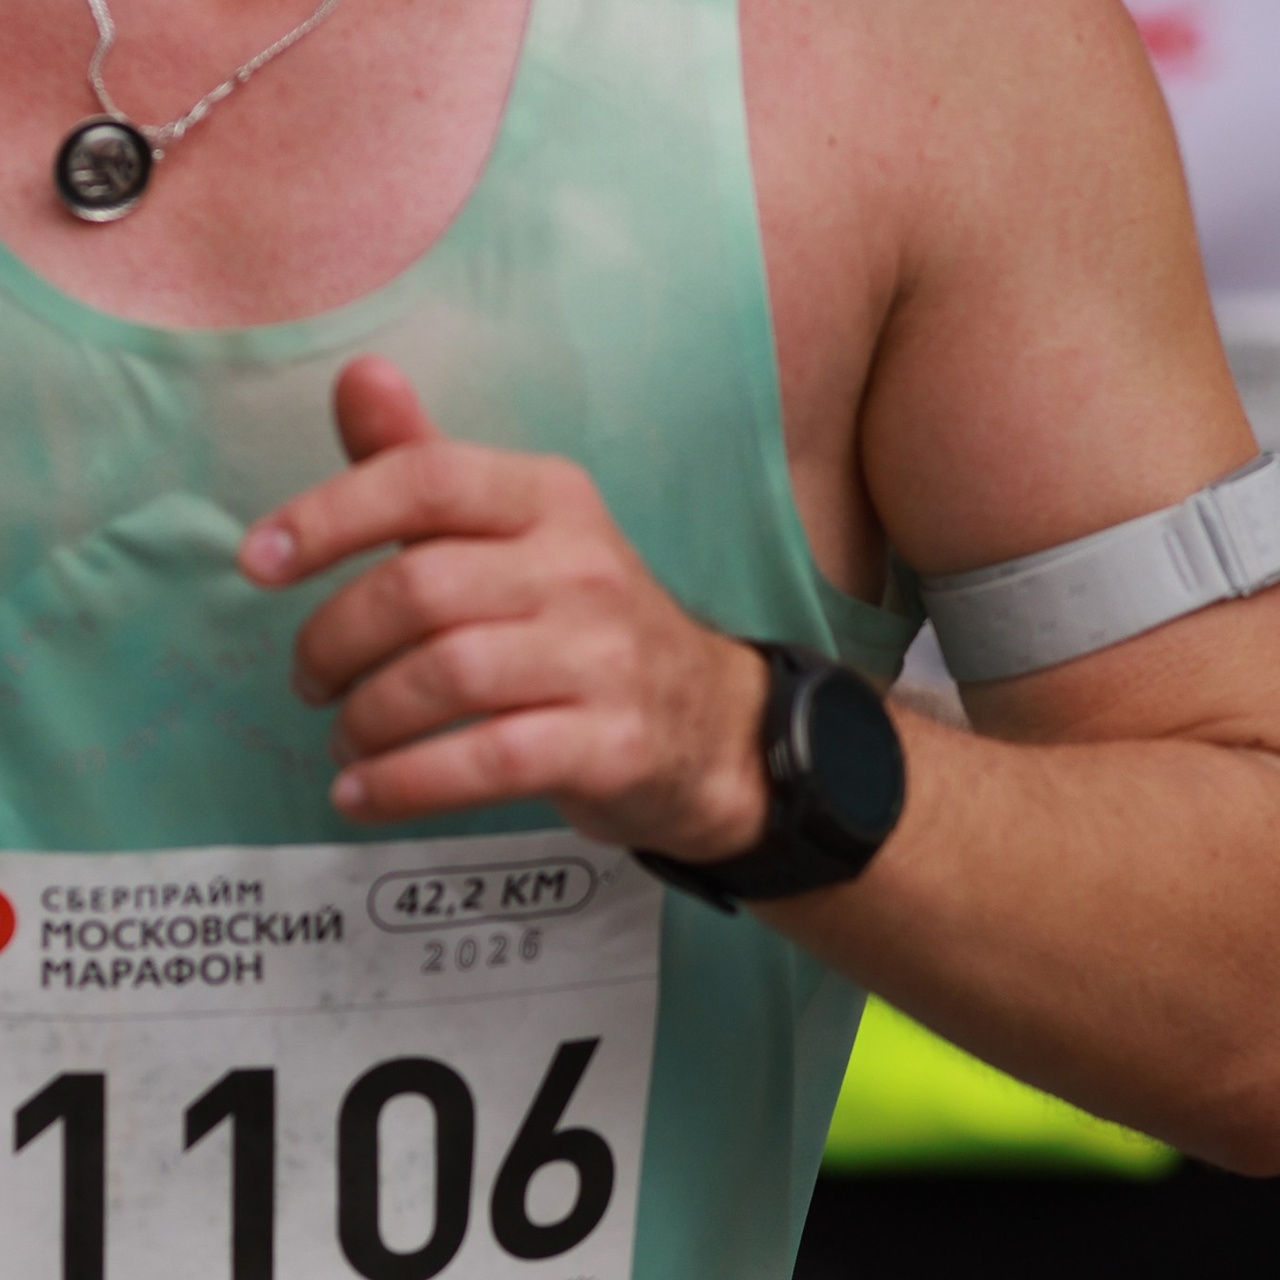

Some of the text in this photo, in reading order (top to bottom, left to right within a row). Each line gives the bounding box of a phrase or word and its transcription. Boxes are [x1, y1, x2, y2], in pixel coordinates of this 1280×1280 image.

[40, 877, 264, 912] СБЕРПРАЙМ
[395, 877, 485, 917] 42,2
[40, 905, 344, 951] МОСКОВСКИЙ
[40, 951, 264, 990] МАРАФОН
